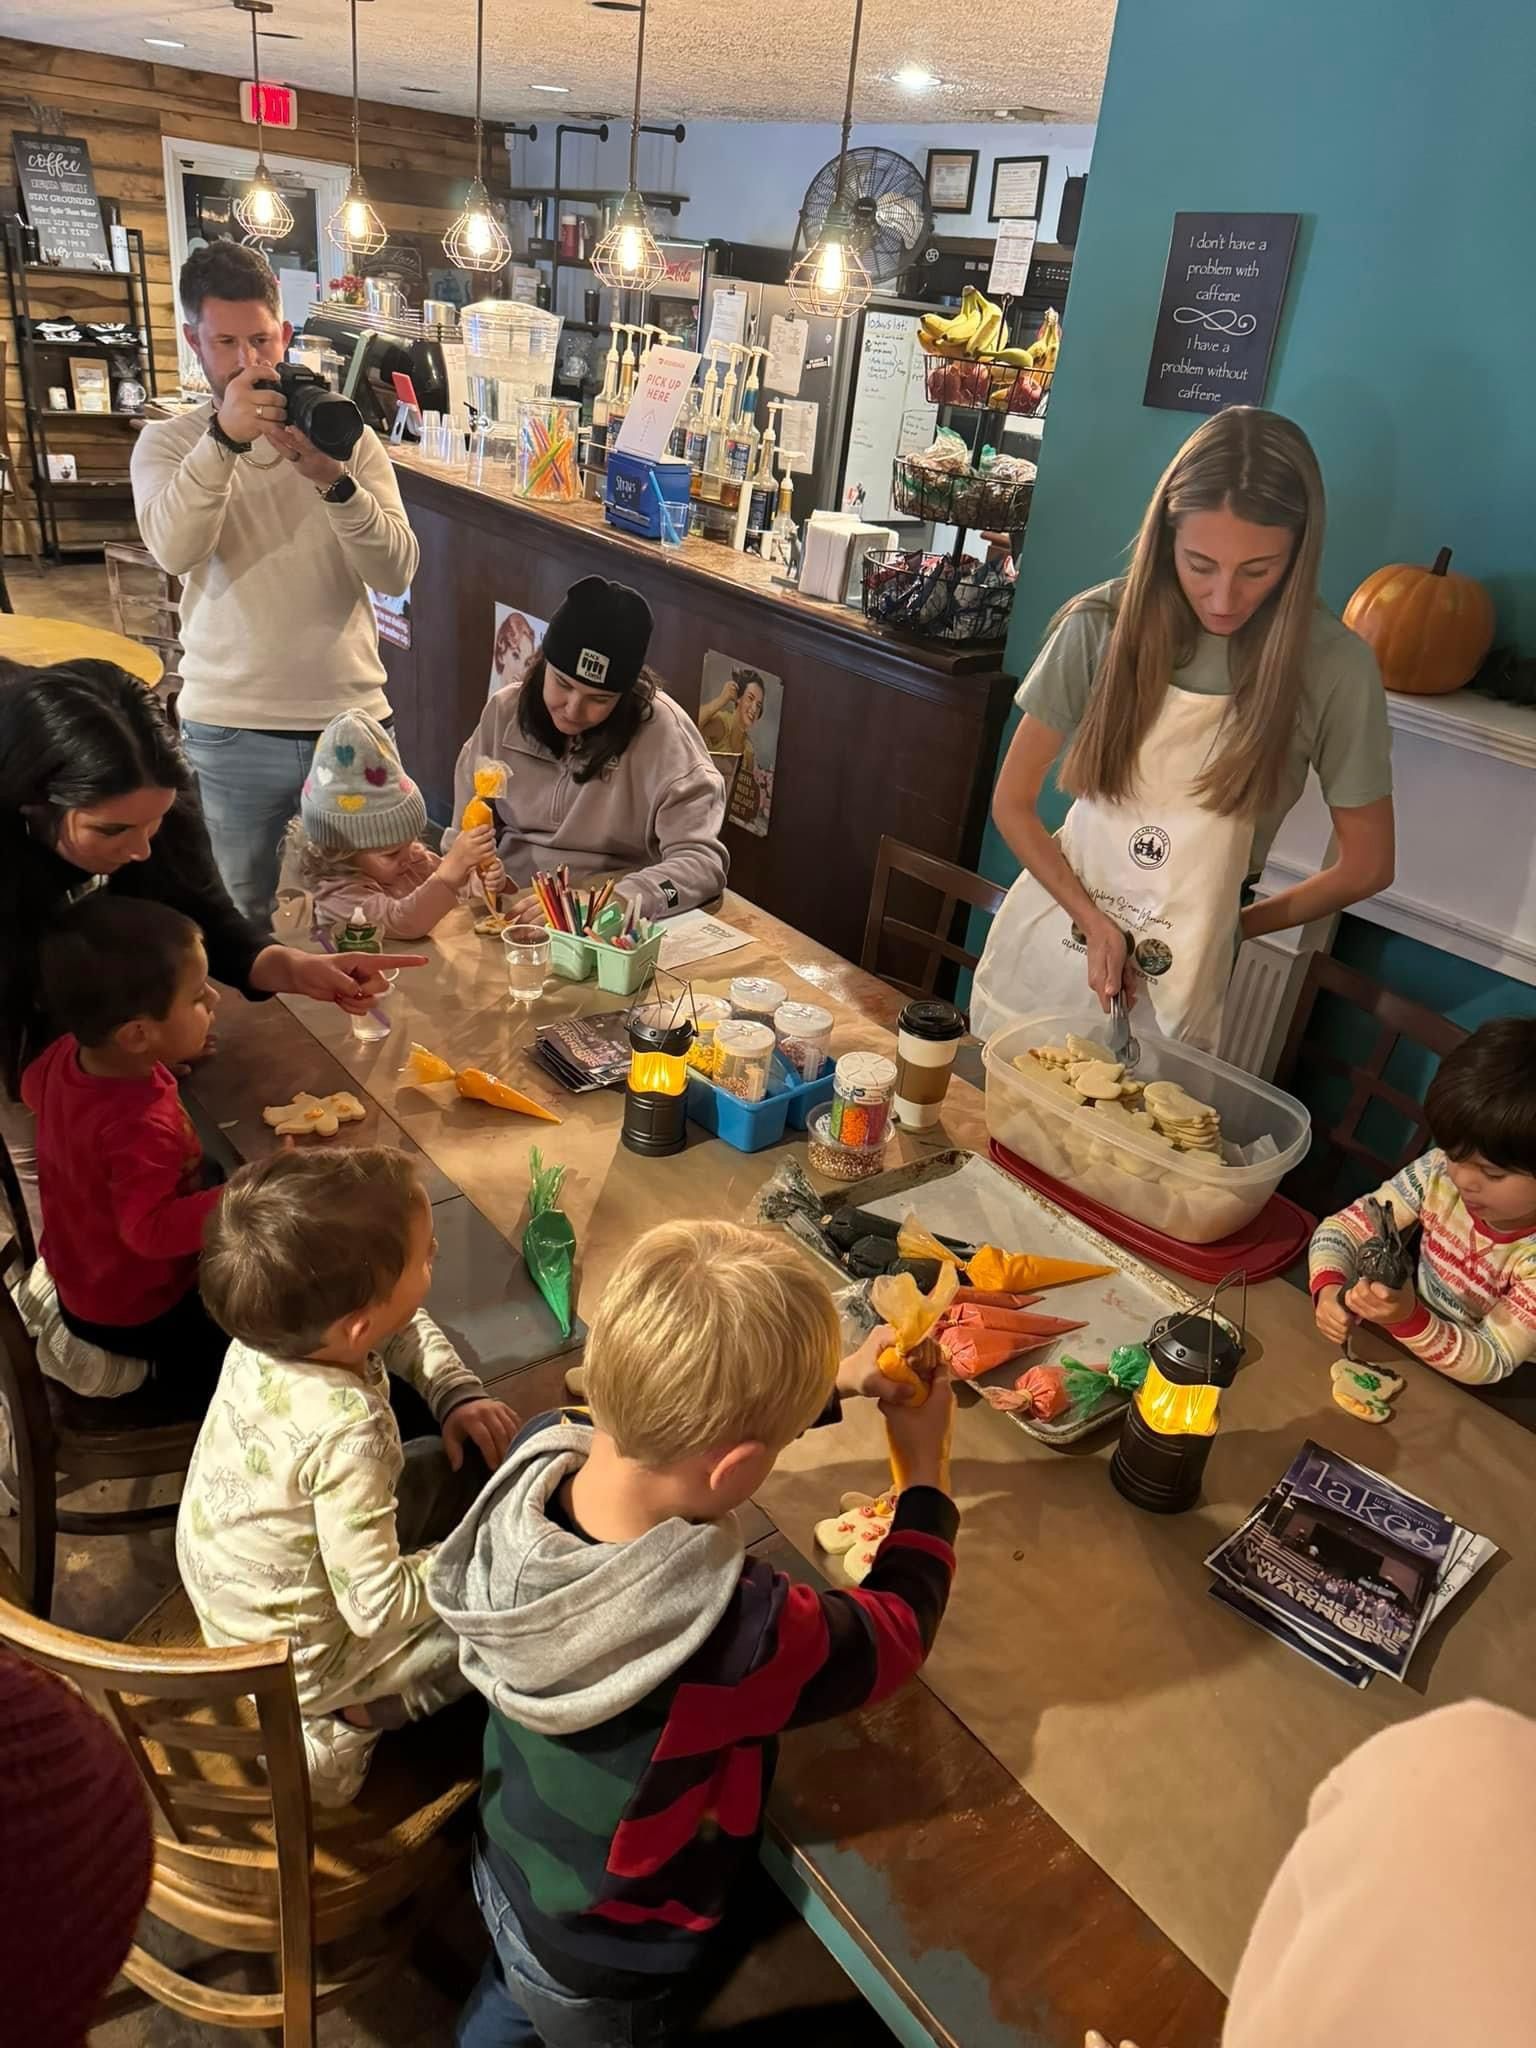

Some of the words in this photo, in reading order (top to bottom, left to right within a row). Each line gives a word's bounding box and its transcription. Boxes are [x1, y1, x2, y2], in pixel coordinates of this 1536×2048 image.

[28, 152, 80, 178] coffee
[28, 192, 49, 202] STAY
[50, 194, 96, 206] GROUNDED
[1189, 236, 1195, 247] I
[1197, 232, 1225, 250] don't
[1228, 232, 1255, 250] have
[1258, 242, 1267, 251] a
[1186, 258, 1232, 281] problem
[1235, 259, 1260, 277] with
[1195, 284, 1241, 303] caffeine
[1186, 337, 1192, 349] I
[1193, 334, 1219, 352] have
[1222, 343, 1230, 353] a
[1160, 358, 1204, 379] problem
[1207, 362, 1249, 381] without
[646, 374, 667, 388] PICK
[670, 379, 681, 390] UP
[647, 389, 671, 403] HERE
[1178, 384, 1222, 403] caffeine
[615, 475, 636, 493] Straws
[1310, 1460, 1437, 1553] lakes
[1256, 1563, 1400, 1656] WARRIORS
[1259, 1557, 1347, 1615] WELCOME
[1349, 1610, 1411, 1643] HOME
